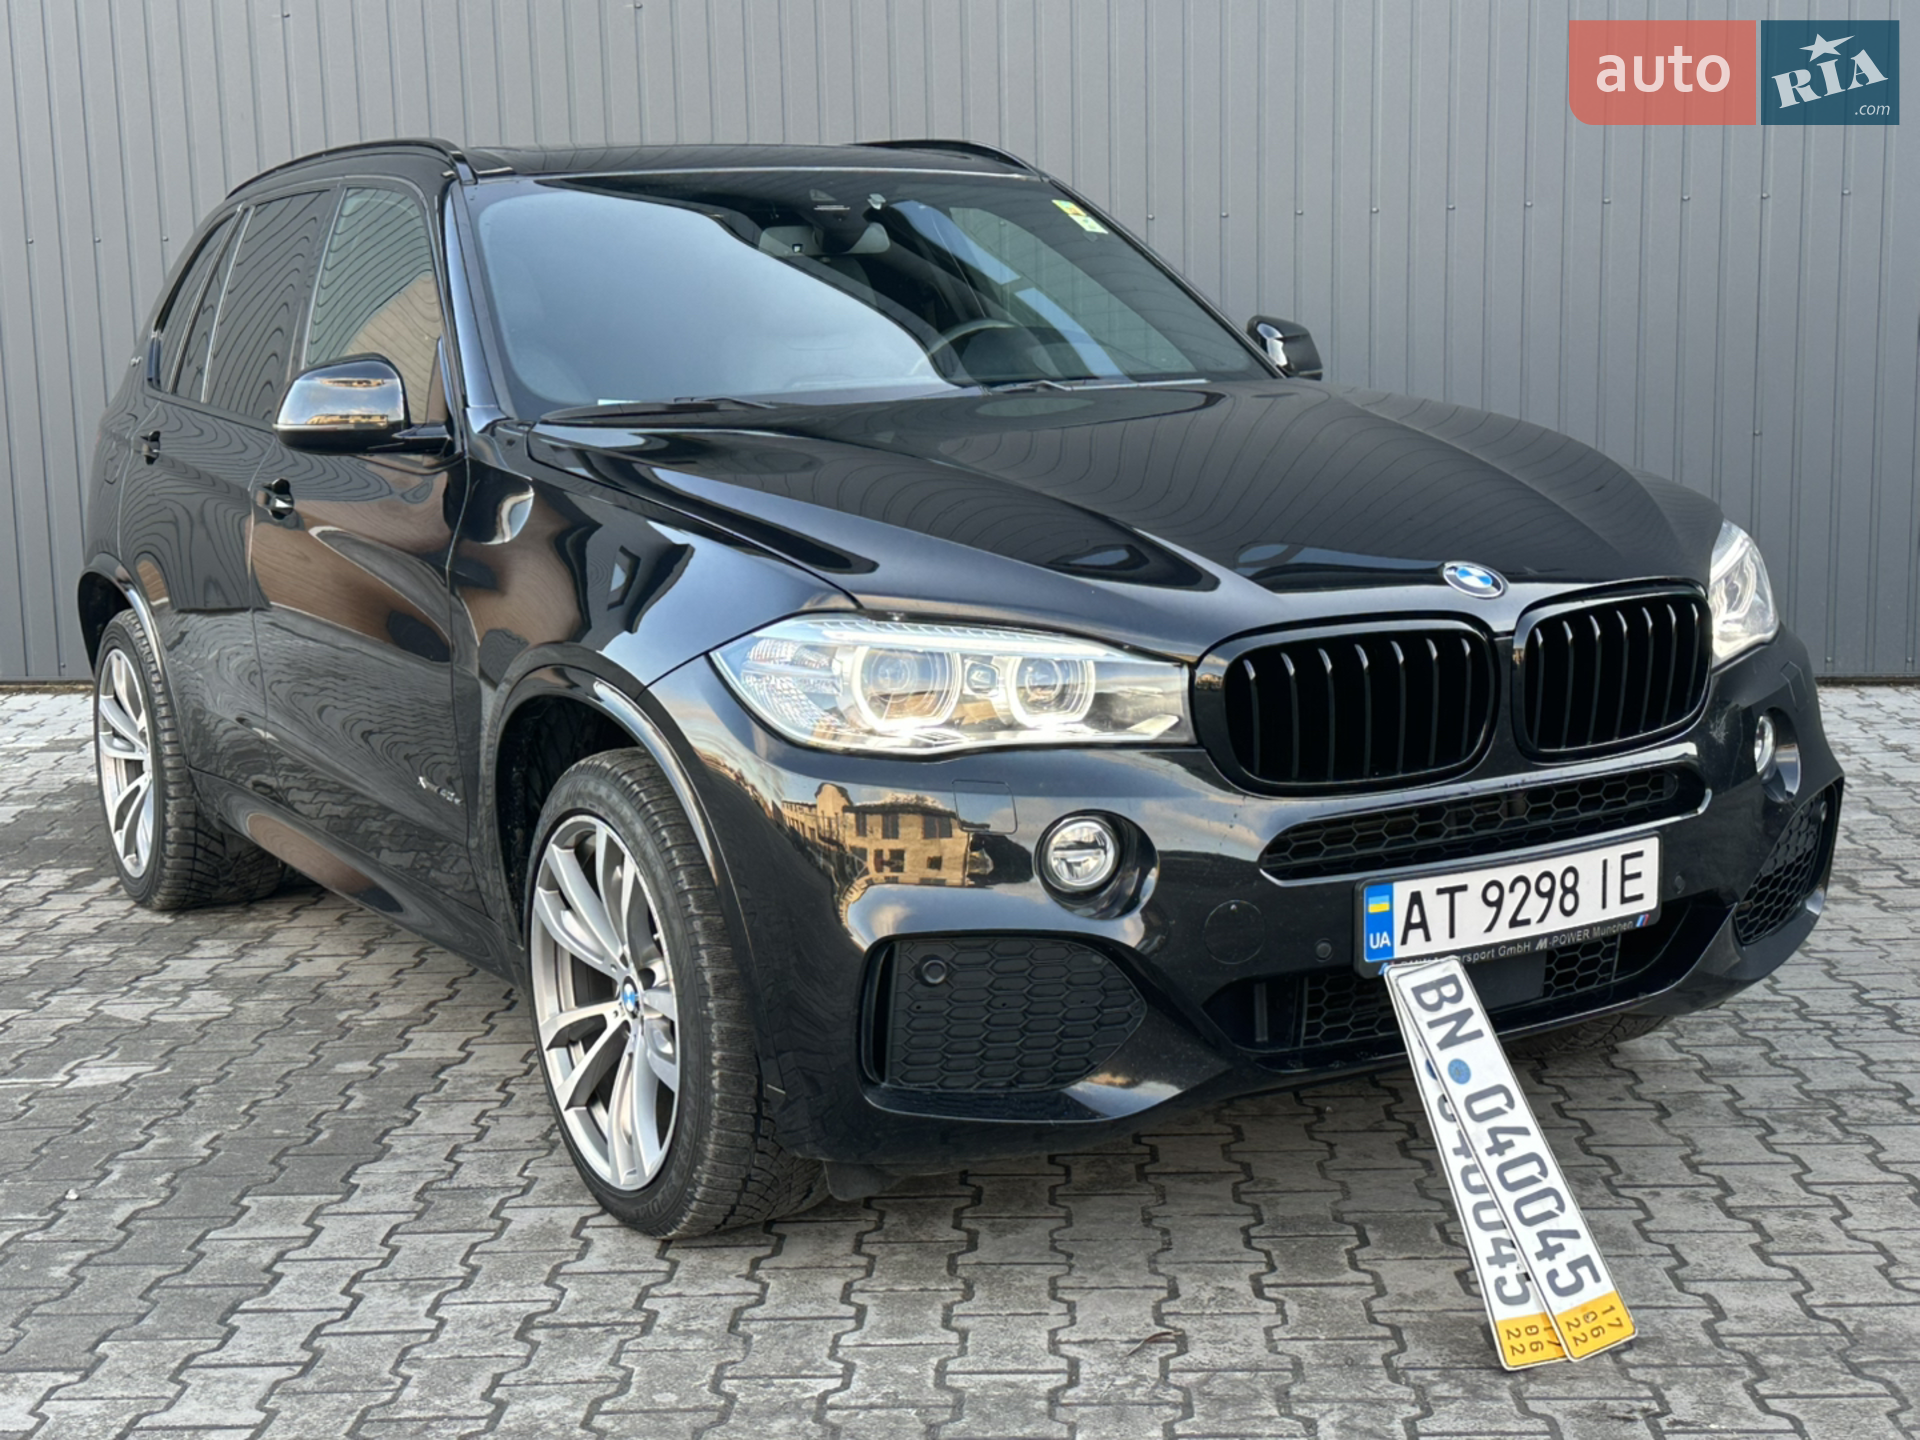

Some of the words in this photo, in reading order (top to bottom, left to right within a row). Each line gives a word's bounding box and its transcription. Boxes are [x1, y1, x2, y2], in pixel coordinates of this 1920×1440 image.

[1400, 884, 1469, 946] AT
[1480, 866, 1580, 934] 9298
[1601, 850, 1645, 910] IE
[1369, 930, 1392, 950] UA
[1498, 941, 1532, 956] GmbH
[1410, 972, 1485, 1052] BN
[1463, 1083, 1602, 1298] 040045
[1582, 1310, 1606, 1339] 06
[1601, 1304, 1625, 1329] 17
[1505, 1327, 1526, 1357] 22
[1524, 1324, 1545, 1353] 06
[1565, 1317, 1589, 1347] 22
